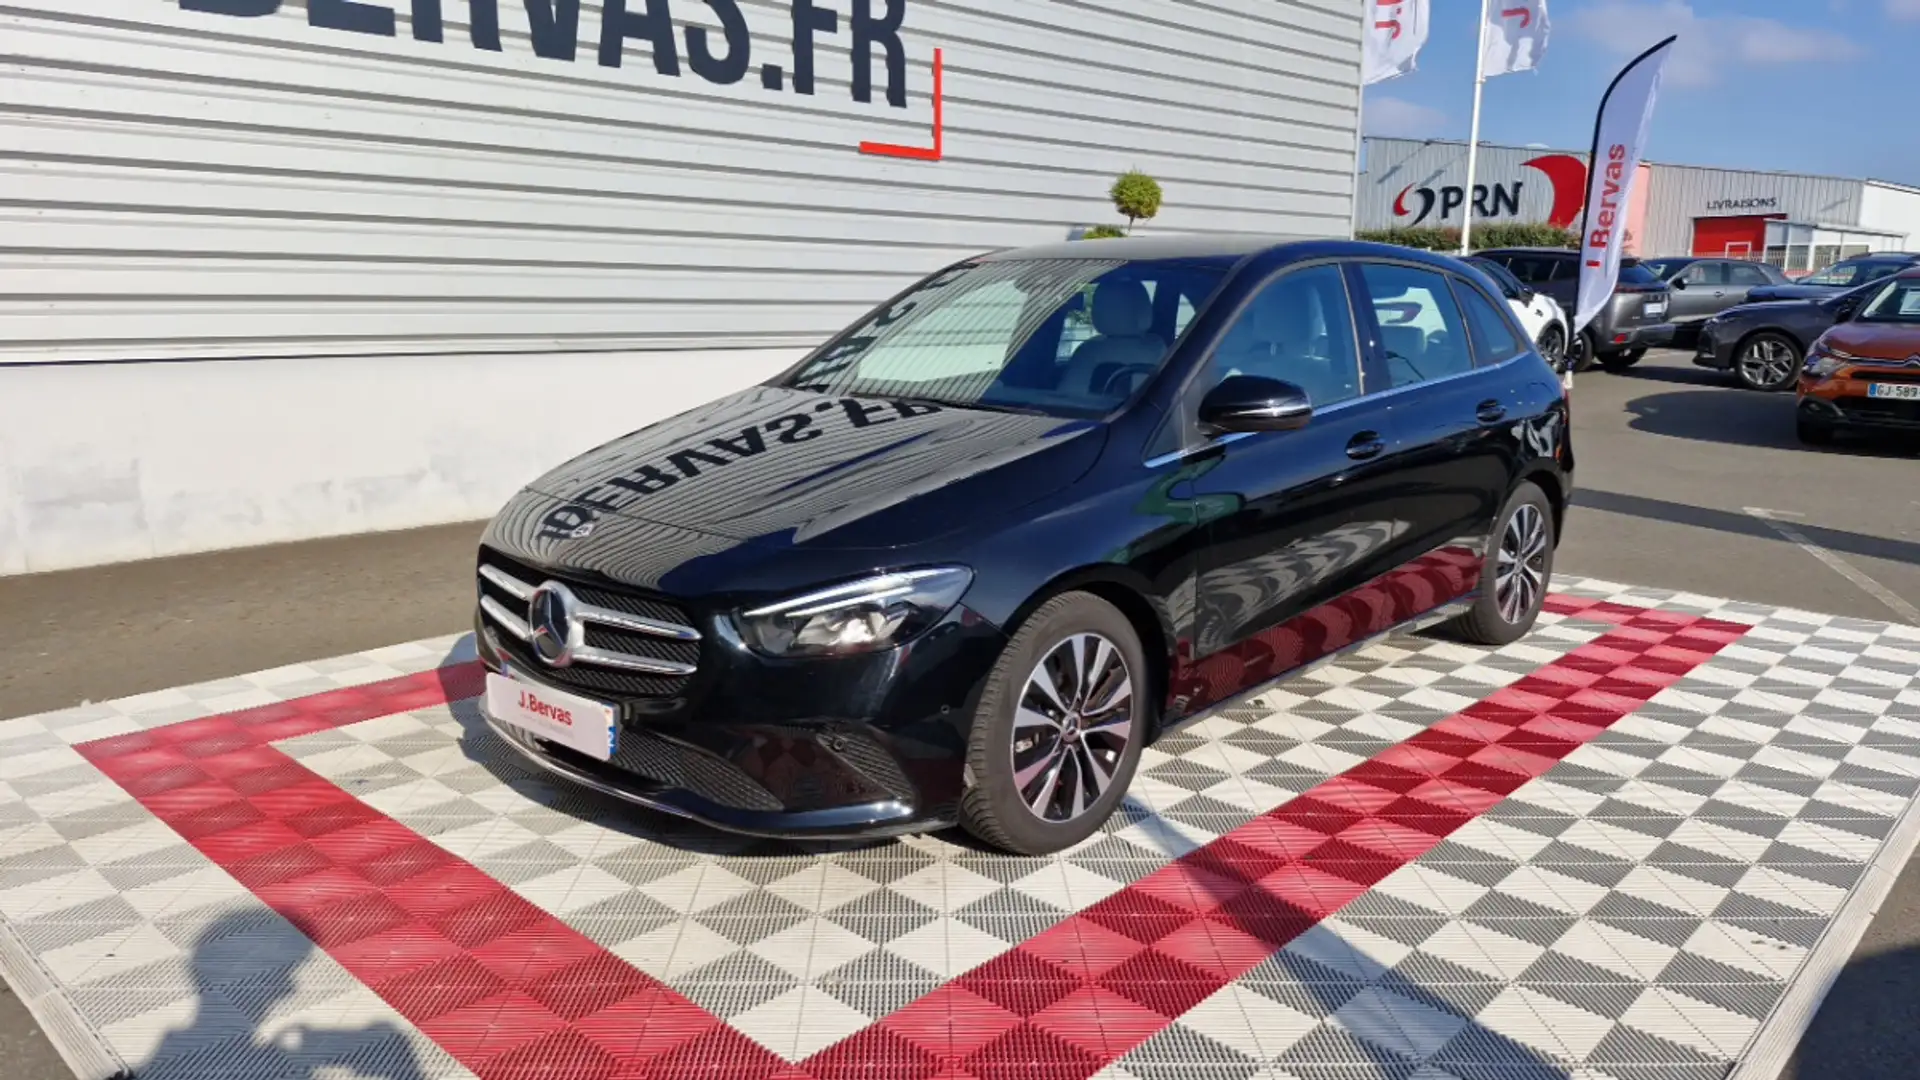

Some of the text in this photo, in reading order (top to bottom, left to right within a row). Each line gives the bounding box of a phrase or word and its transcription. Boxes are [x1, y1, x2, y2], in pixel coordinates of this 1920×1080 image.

[1440, 179, 1523, 219] PRN
[1706, 197, 1777, 210] LIVRAISONS
[518, 689, 573, 727] J.Bervas
